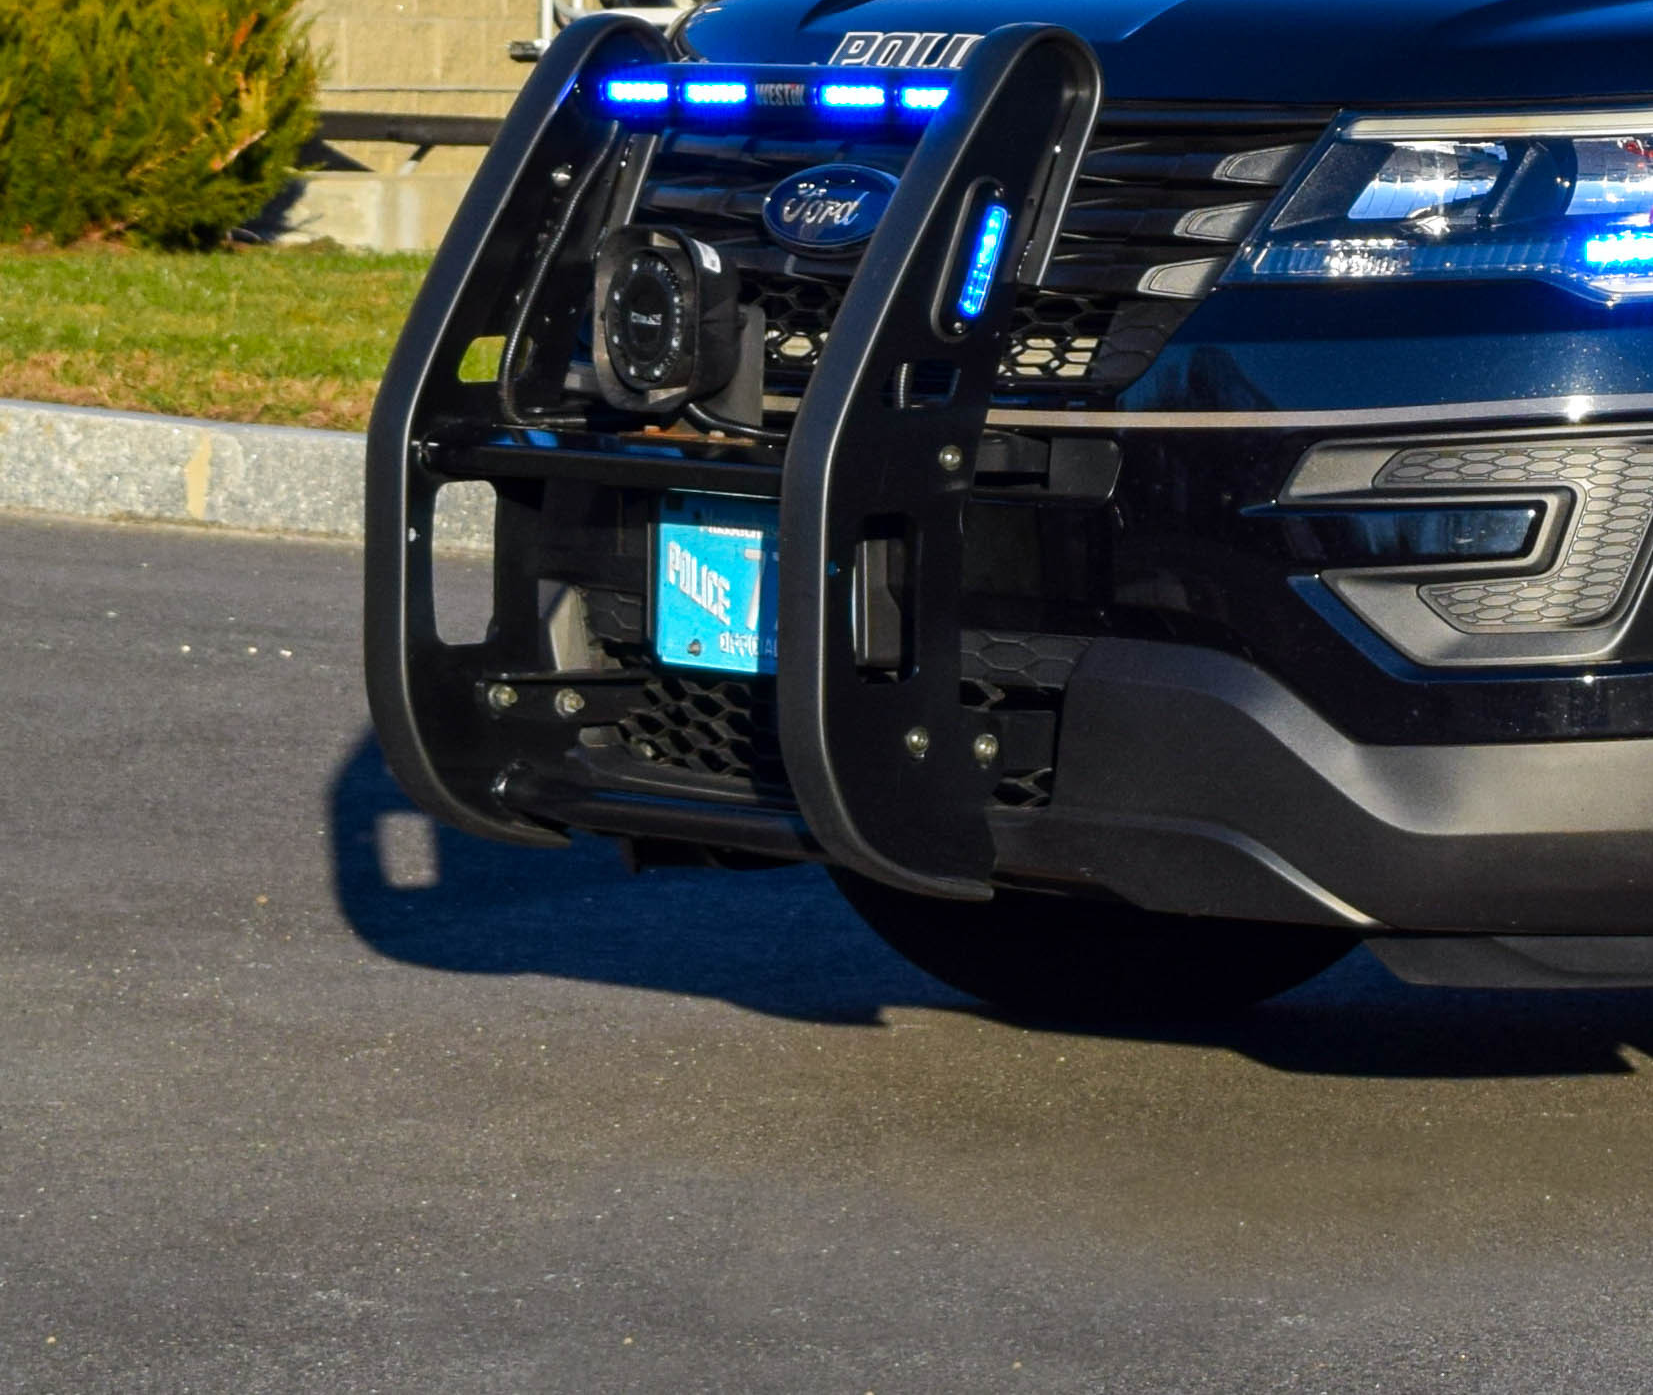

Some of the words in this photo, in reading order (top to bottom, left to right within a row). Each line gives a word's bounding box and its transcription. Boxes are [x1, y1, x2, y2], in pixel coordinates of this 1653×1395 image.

[828, 32, 985, 69] POLI
[782, 183, 870, 226] Ford
[667, 541, 731, 626] POLICE
